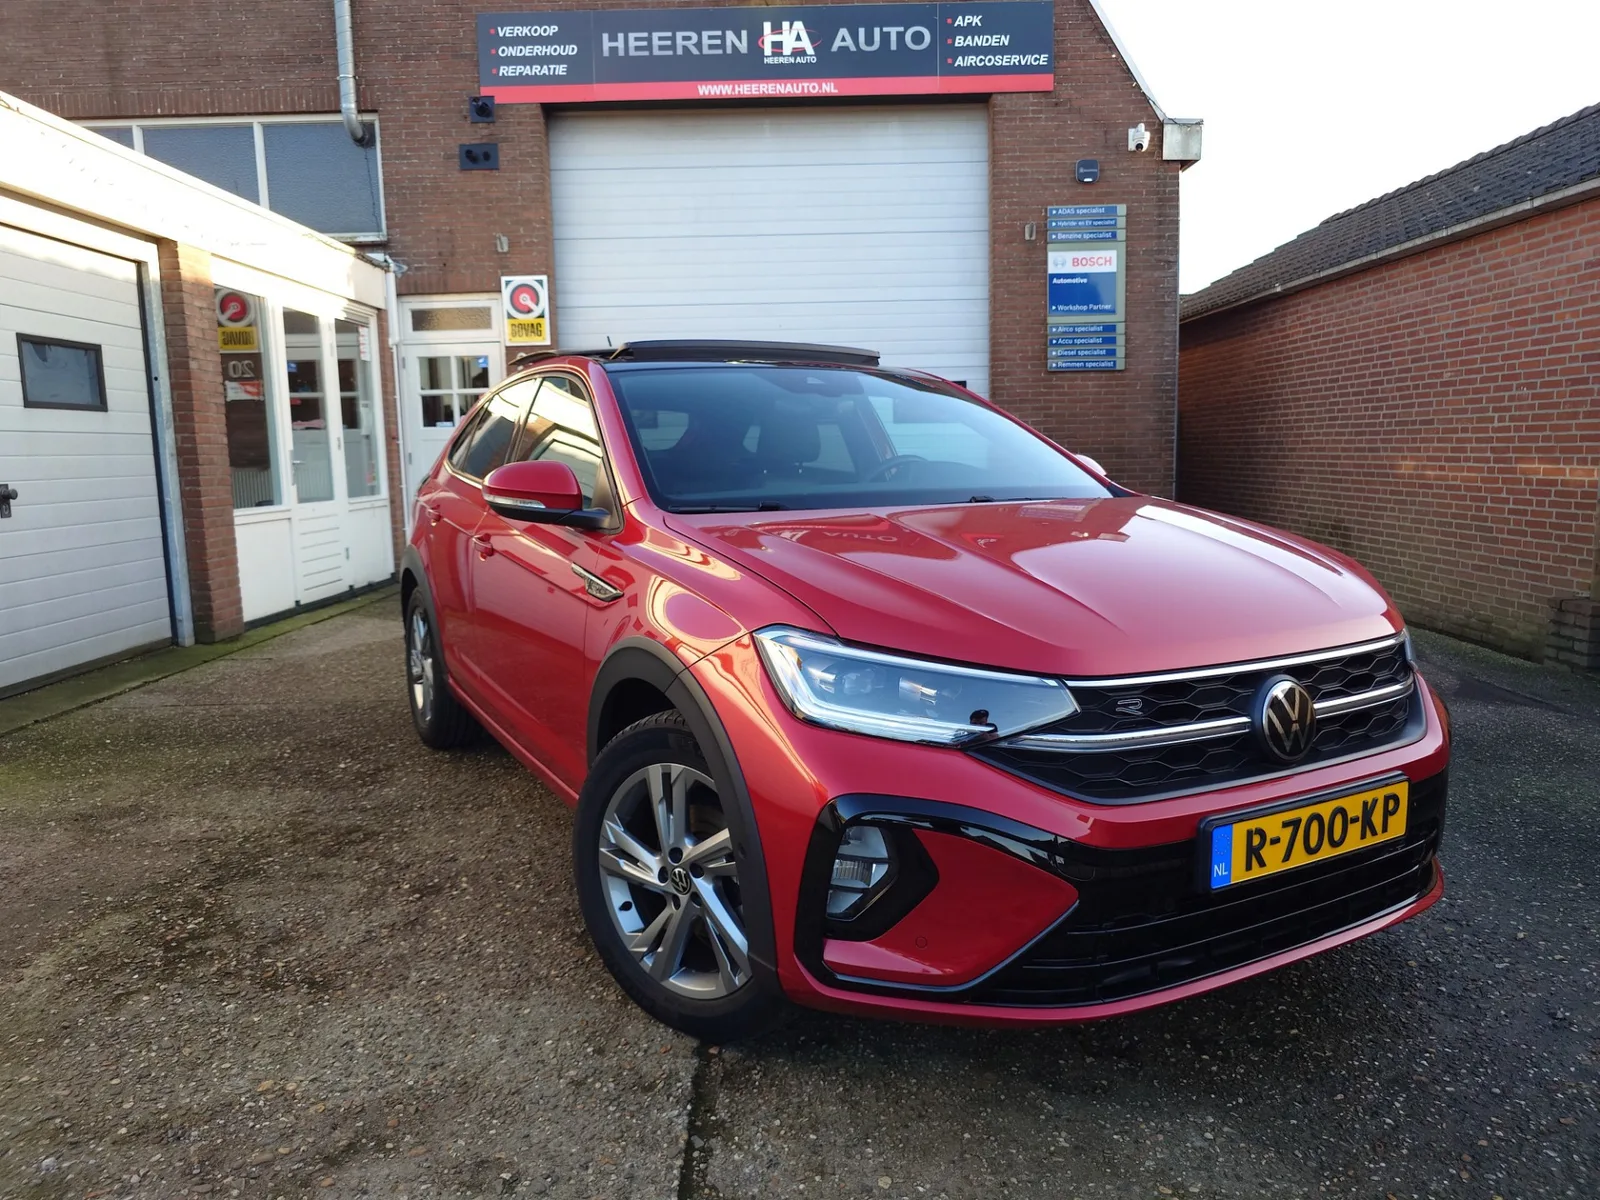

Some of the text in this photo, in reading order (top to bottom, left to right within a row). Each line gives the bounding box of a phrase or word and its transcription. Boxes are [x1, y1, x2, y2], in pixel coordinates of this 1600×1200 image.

[954, 15, 983, 27] APK
[497, 25, 558, 37] VERKOOP
[601, 26, 932, 57] HEEREN AUTO
[763, 21, 815, 56] HA
[954, 35, 1010, 47] BANDEN
[498, 45, 577, 57] ONDERHOUD
[764, 56, 817, 64] HEEREN AUTO
[954, 54, 1049, 67] AIRCOSERVICE
[499, 64, 567, 76] REPARATIE
[697, 82, 838, 96] WWW.HEERENAUTO.NL
[1076, 207, 1105, 215] specialist
[1083, 232, 1112, 240] specialist
[1072, 256, 1112, 267] BOSCH
[510, 323, 542, 338] BOVAG
[1074, 325, 1103, 333] specialist
[1074, 337, 1102, 345] specialist
[1085, 360, 1114, 368] specialist
[1244, 792, 1401, 872] R-700-KP
[1213, 862, 1229, 878] NL
